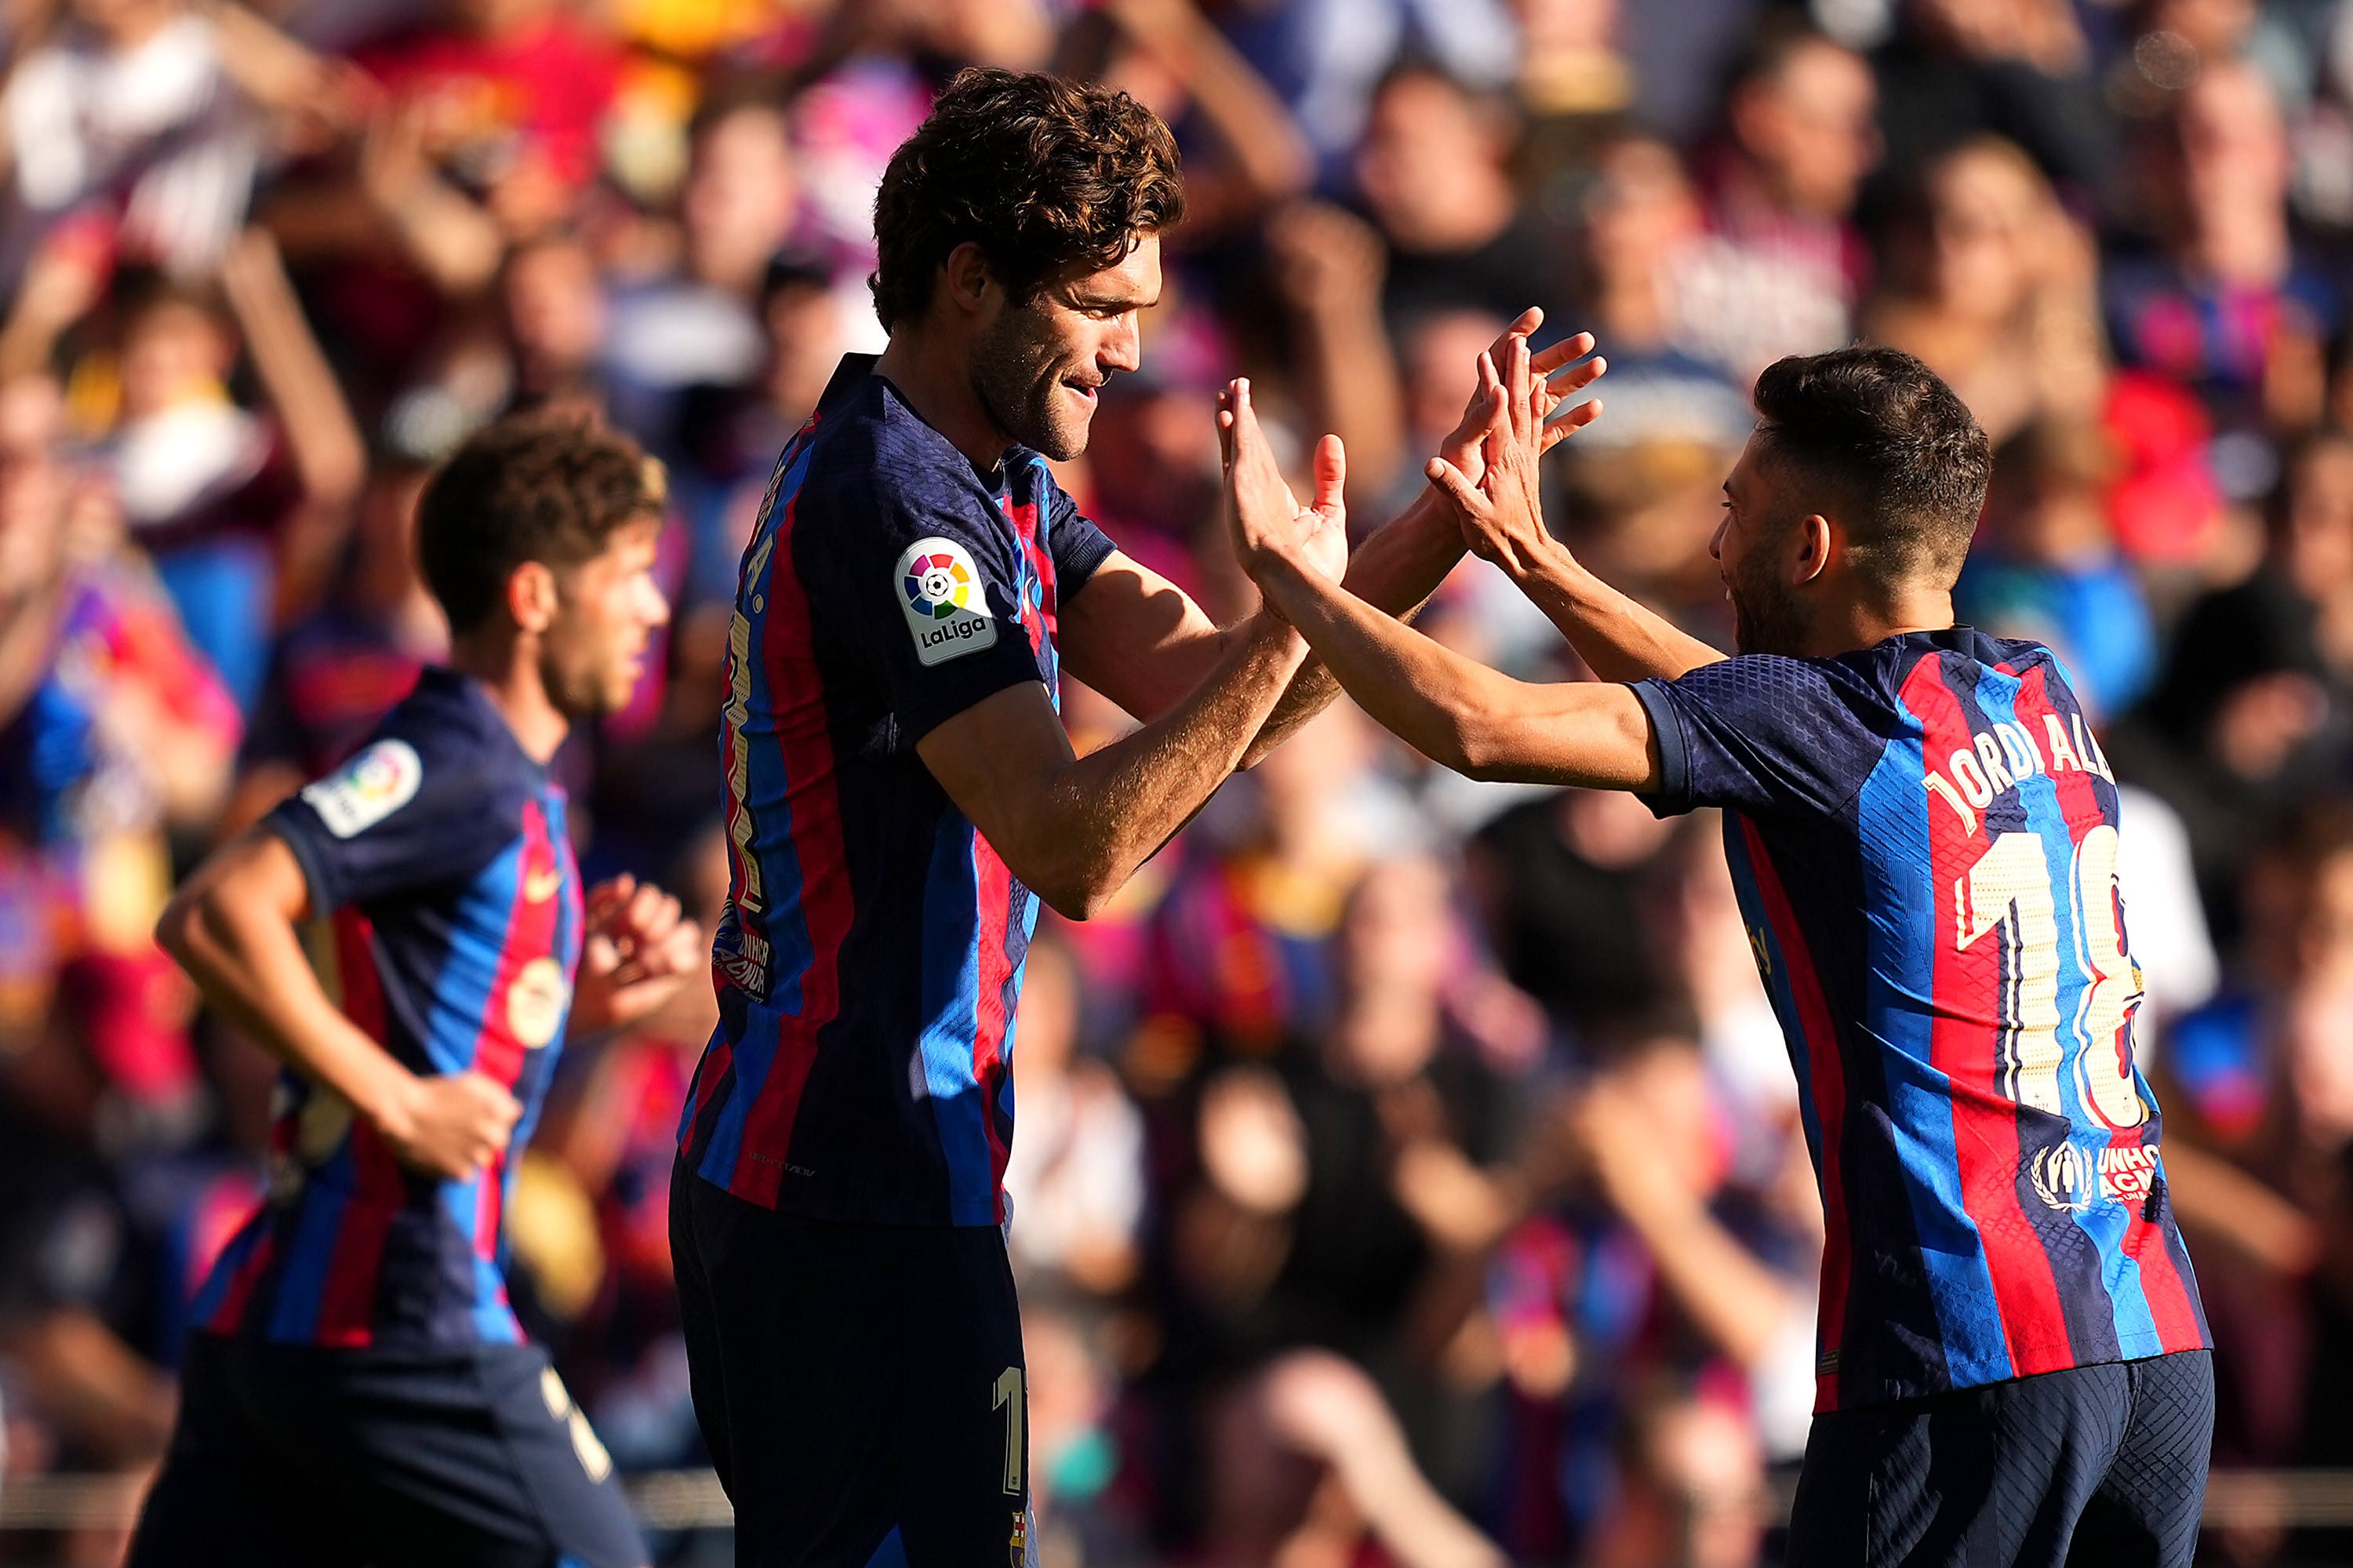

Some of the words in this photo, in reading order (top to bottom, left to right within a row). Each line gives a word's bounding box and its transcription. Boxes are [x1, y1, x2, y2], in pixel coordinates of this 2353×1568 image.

[921, 617, 987, 649] LaLiga
[1921, 719, 2046, 838] JORDI
[1955, 824, 2149, 1129] 18
[2097, 1144, 2161, 1174] UNHC
